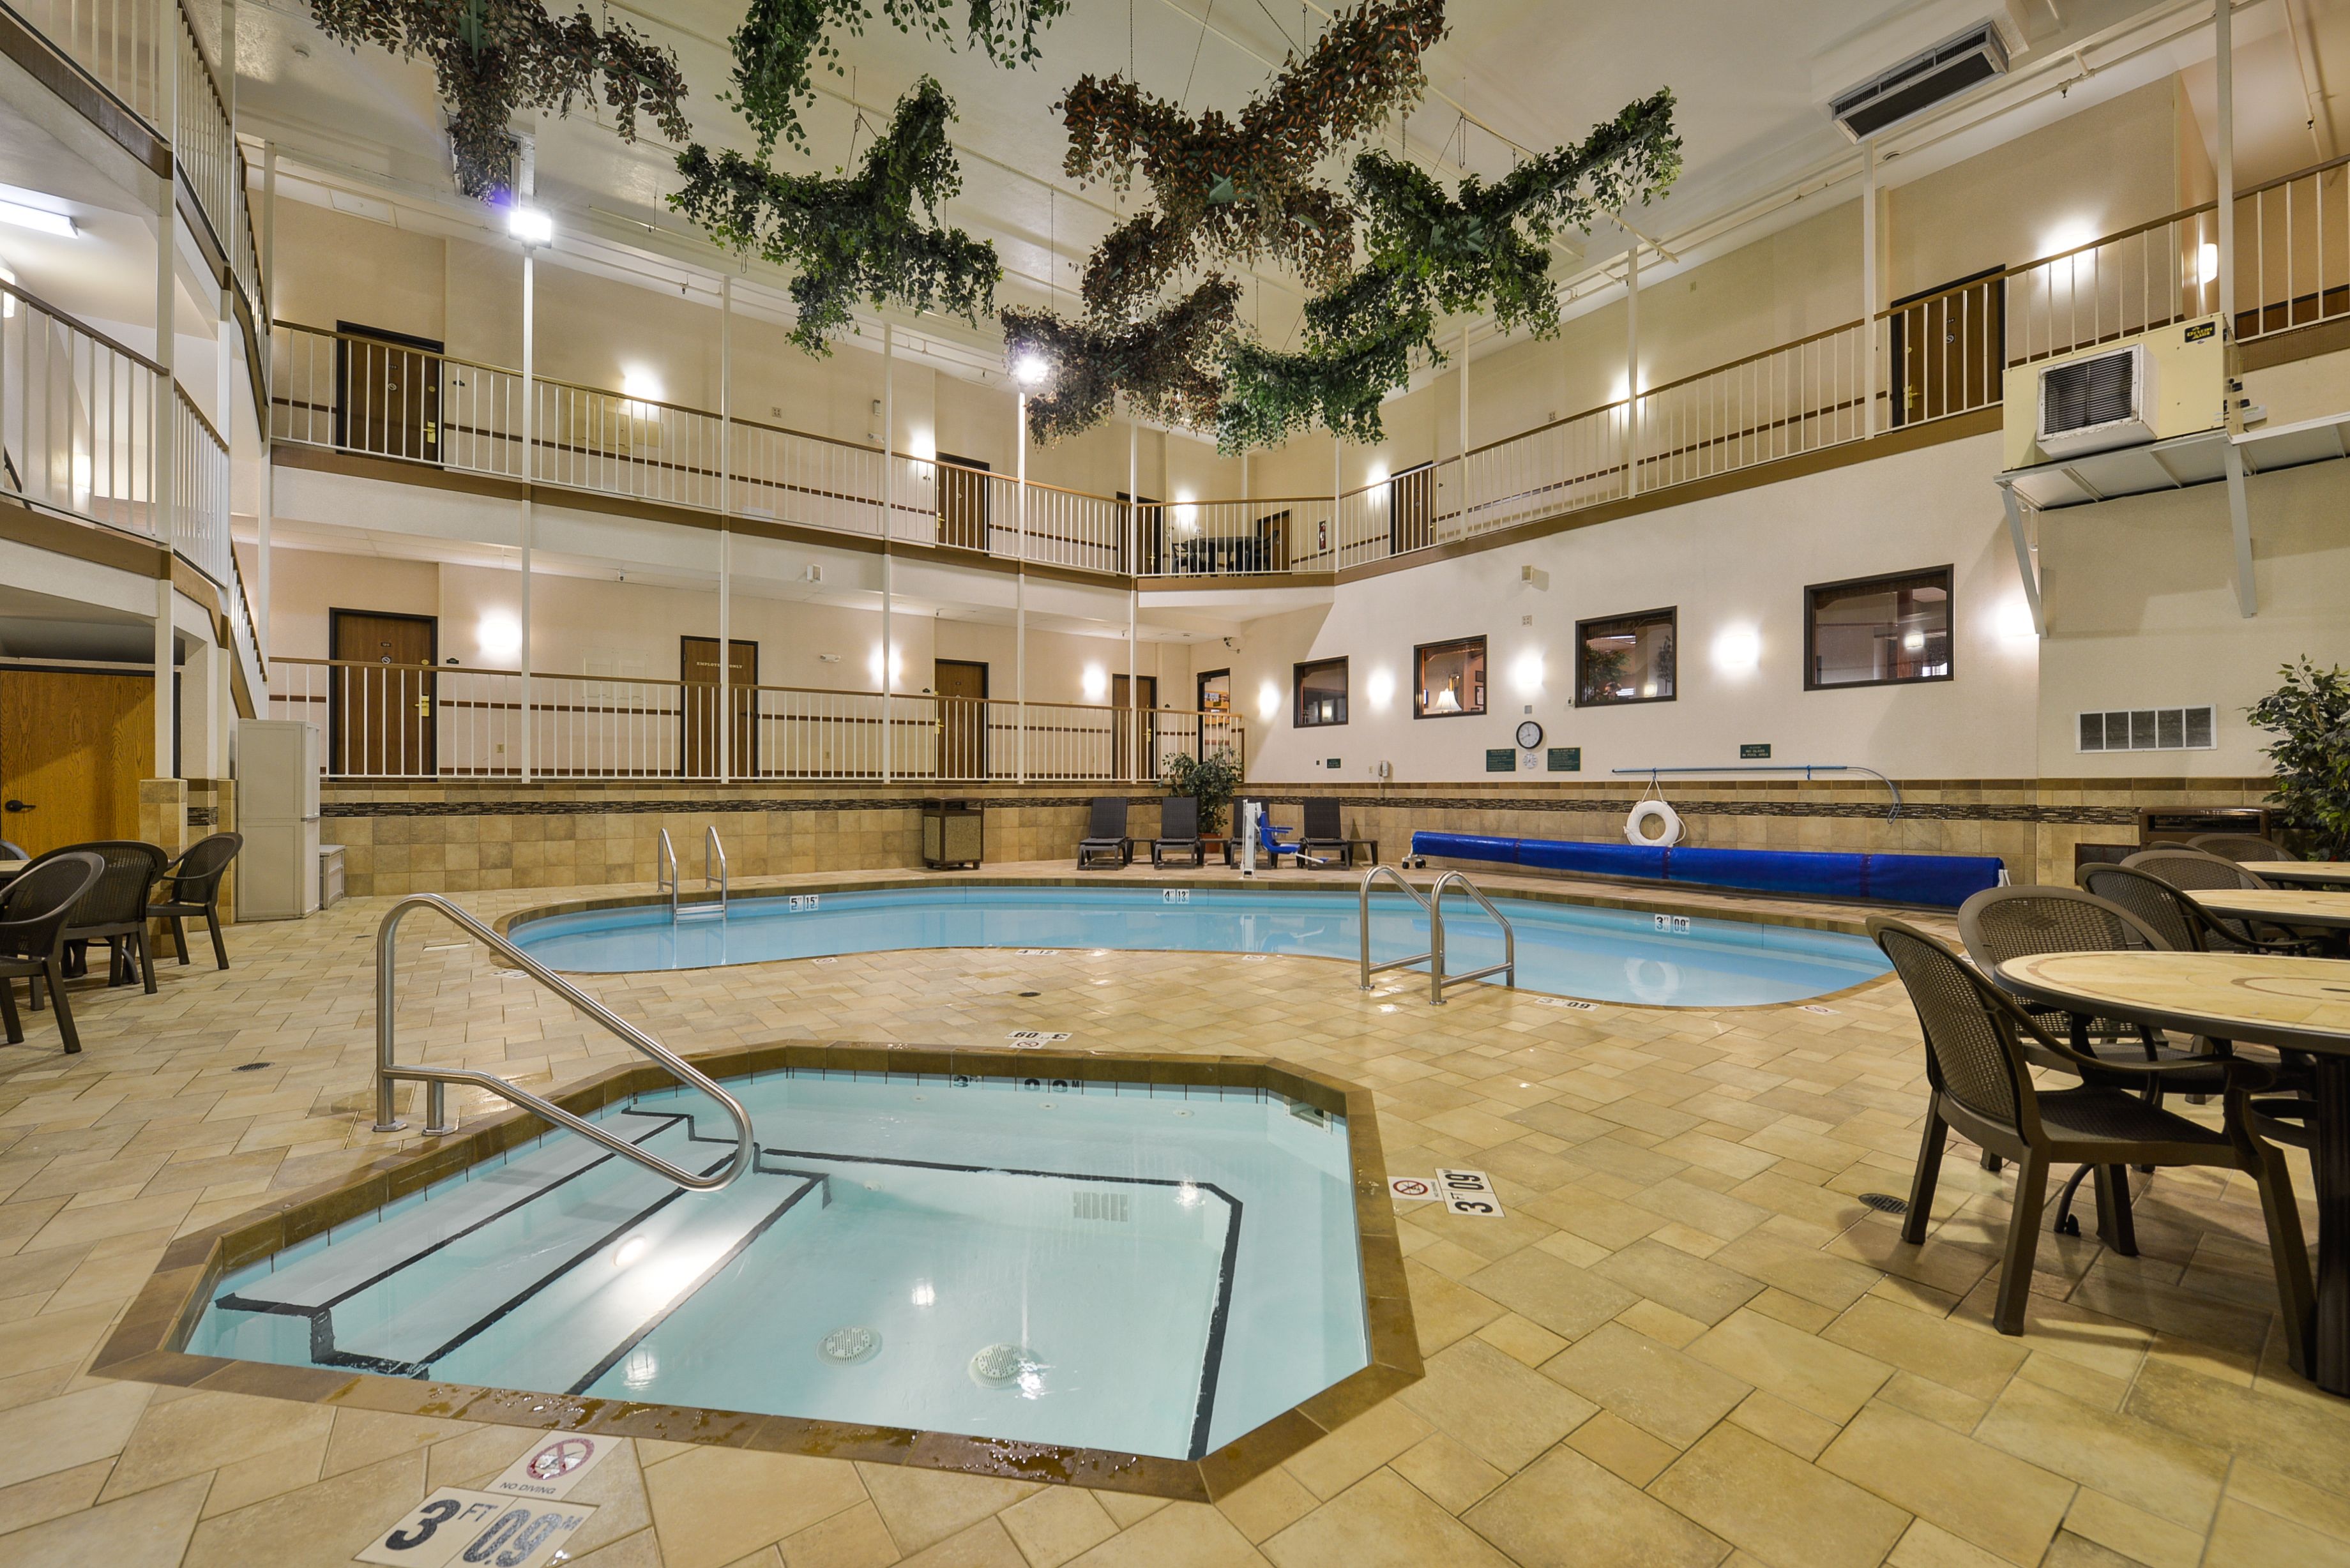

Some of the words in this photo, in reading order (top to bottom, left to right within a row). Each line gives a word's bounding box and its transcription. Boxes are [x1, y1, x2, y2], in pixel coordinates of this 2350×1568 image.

[1072, 1080, 1080, 1088] M
[1450, 1192, 1465, 1200] FT
[1454, 1201, 1493, 1213] 3
[519, 1484, 556, 1495] DIVING
[384, 1499, 461, 1550] 3
[458, 1503, 499, 1522] FT
